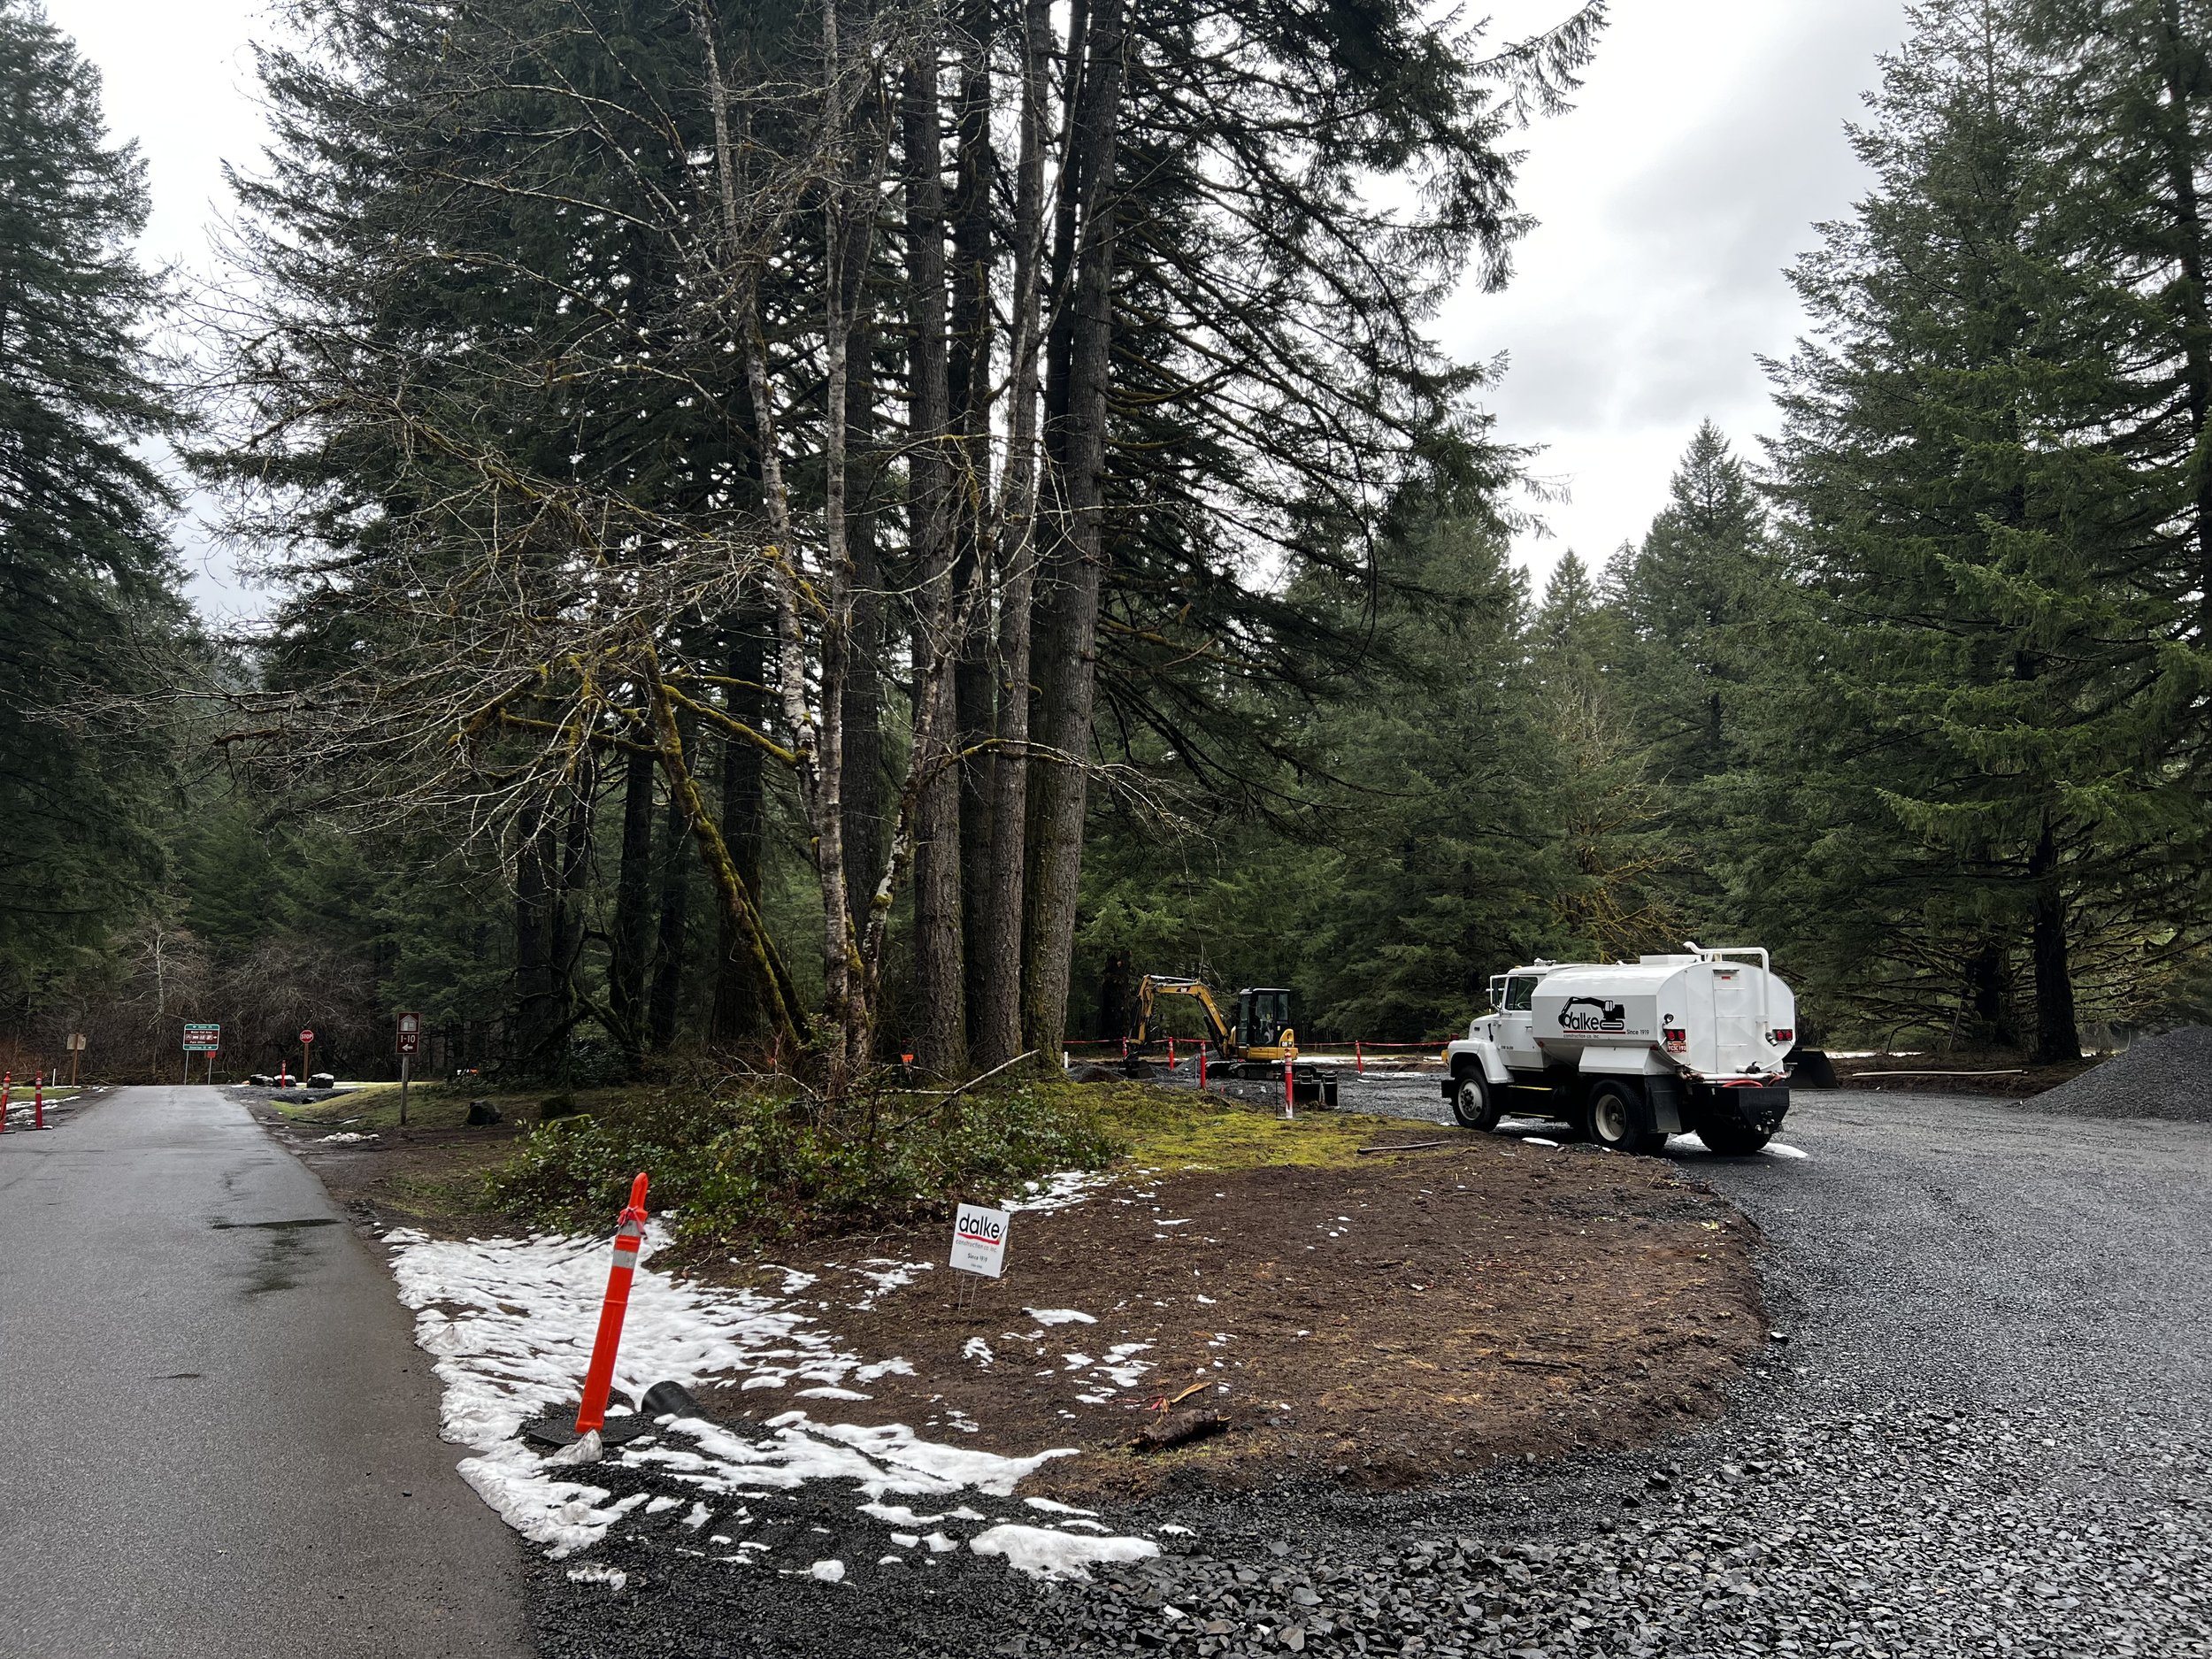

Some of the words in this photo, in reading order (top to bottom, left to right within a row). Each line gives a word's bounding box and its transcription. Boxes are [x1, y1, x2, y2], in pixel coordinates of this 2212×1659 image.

[1563, 1011, 1599, 1030] dalke
[959, 1213, 1000, 1239] dalke
[956, 1240, 984, 1248] construction
